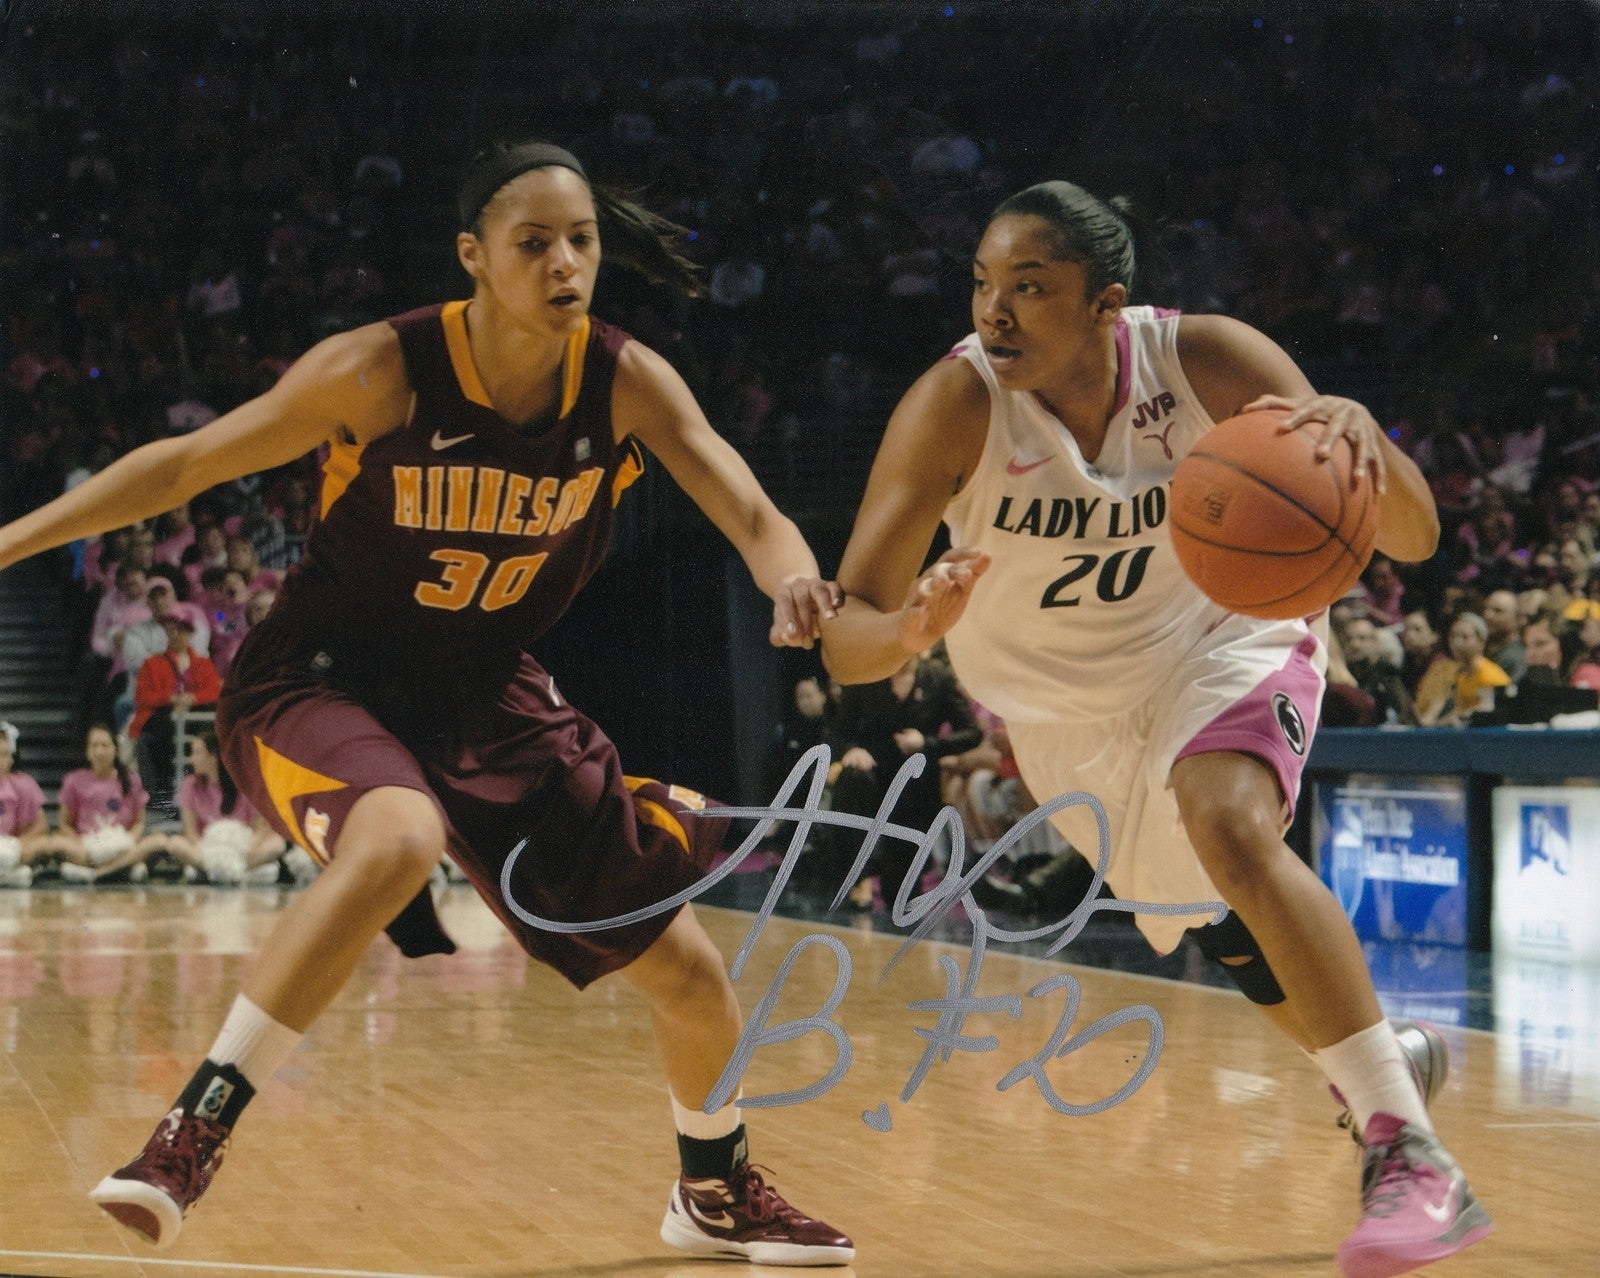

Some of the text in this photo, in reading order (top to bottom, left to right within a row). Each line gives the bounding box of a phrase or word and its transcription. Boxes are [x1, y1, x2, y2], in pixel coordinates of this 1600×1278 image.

[1132, 391, 1176, 429] JVP
[992, 495, 1101, 539] LADY
[1106, 480, 1175, 539] LIO
[414, 548, 549, 612] 30
[1040, 545, 1156, 608] 20
